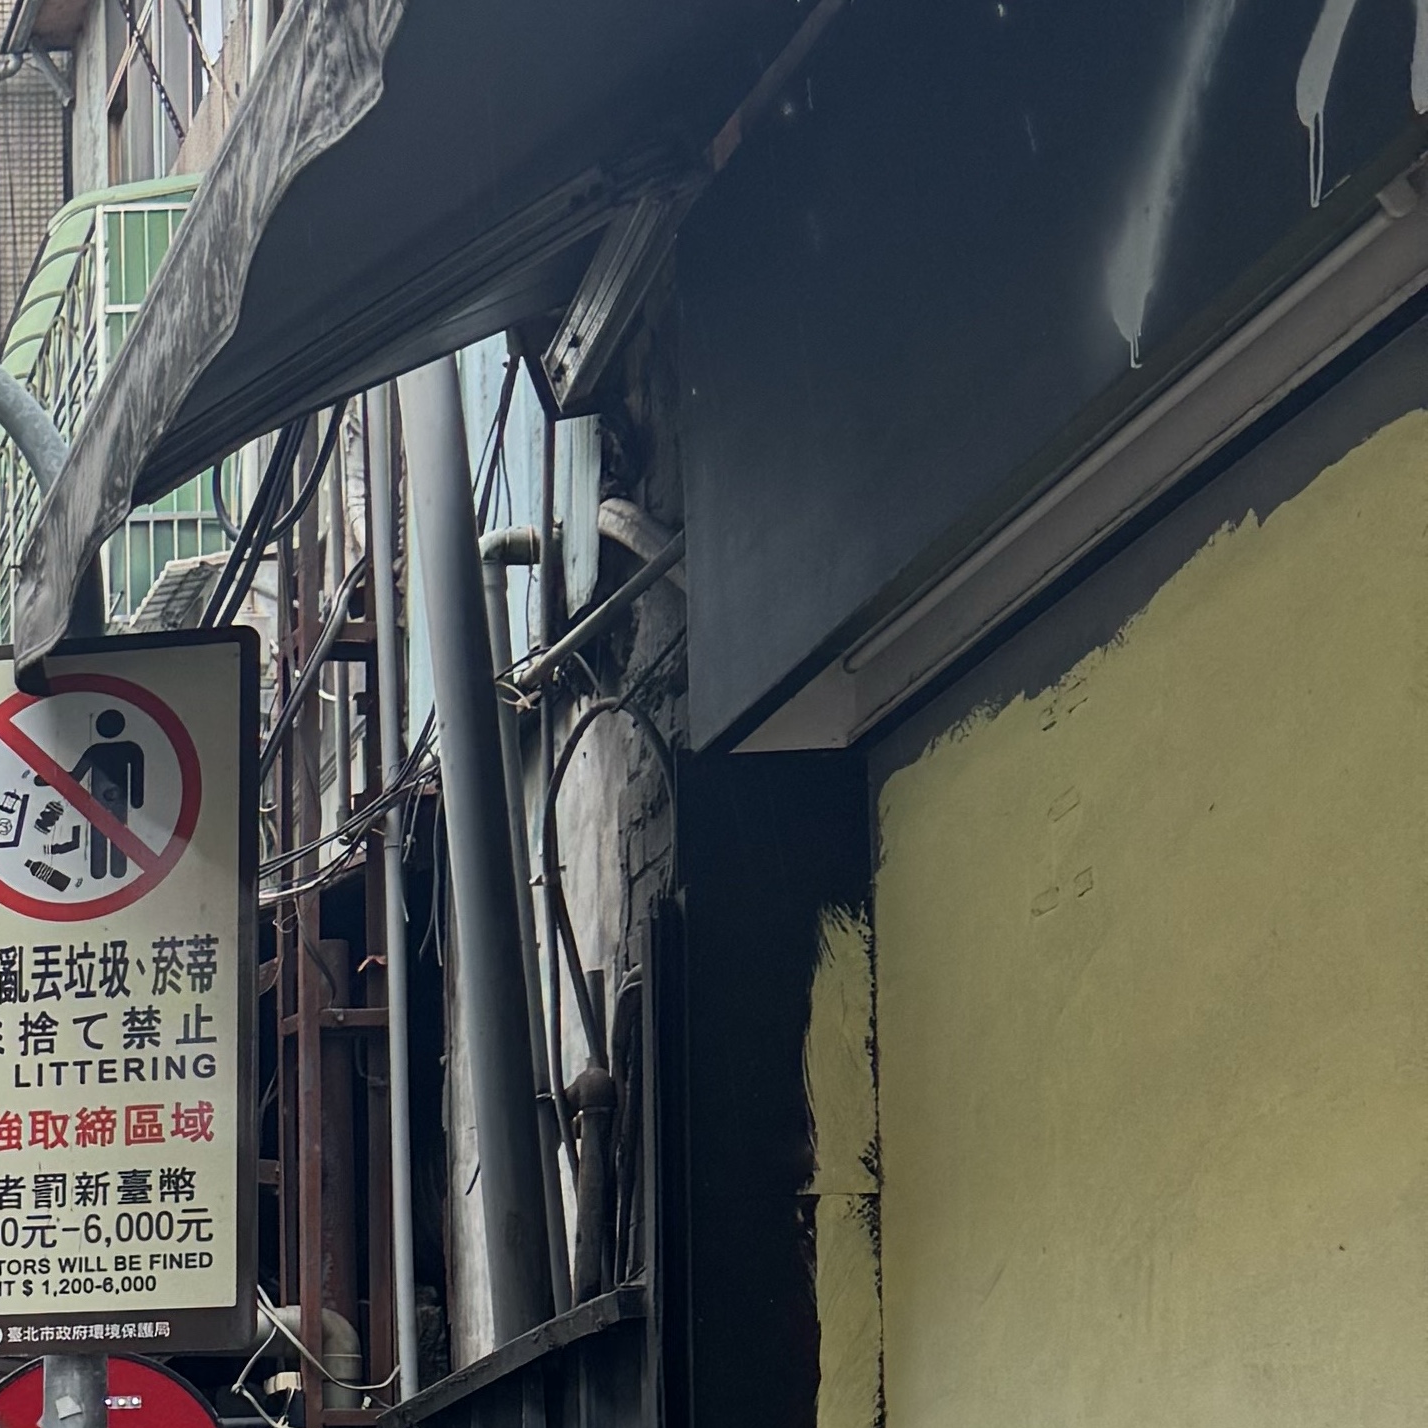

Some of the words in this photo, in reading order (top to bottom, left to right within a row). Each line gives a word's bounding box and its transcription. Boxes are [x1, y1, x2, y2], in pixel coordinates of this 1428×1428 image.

[14, 1054, 216, 1088] LITTERING
[58, 1256, 107, 1273] WILL
[114, 1255, 141, 1271] BE
[149, 1252, 213, 1269] FINED
[42, 1275, 157, 1297] 1,200-6,000
